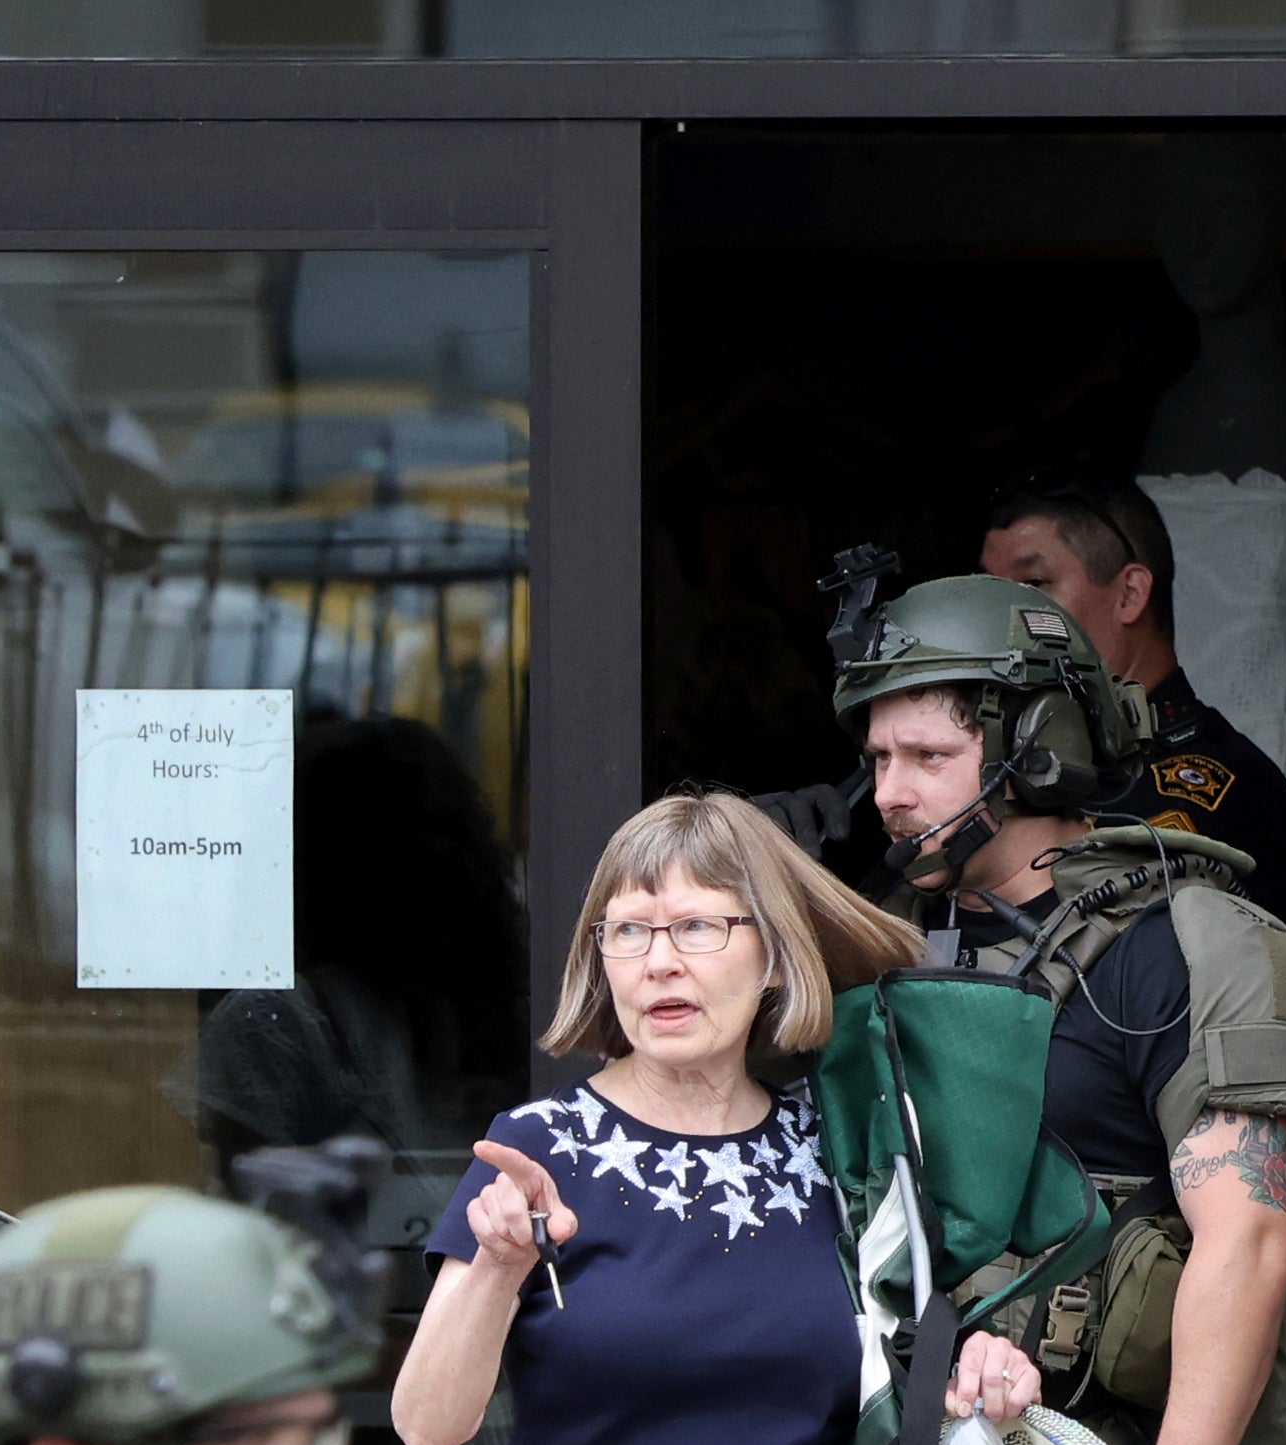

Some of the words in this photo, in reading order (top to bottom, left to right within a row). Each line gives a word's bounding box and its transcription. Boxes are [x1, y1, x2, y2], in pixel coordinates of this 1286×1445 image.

[136, 720, 164, 743] 4th
[169, 722, 191, 743] of
[195, 723, 235, 748] July
[152, 760, 219, 778] Hours:
[130, 836, 243, 860] 10am-5pm
